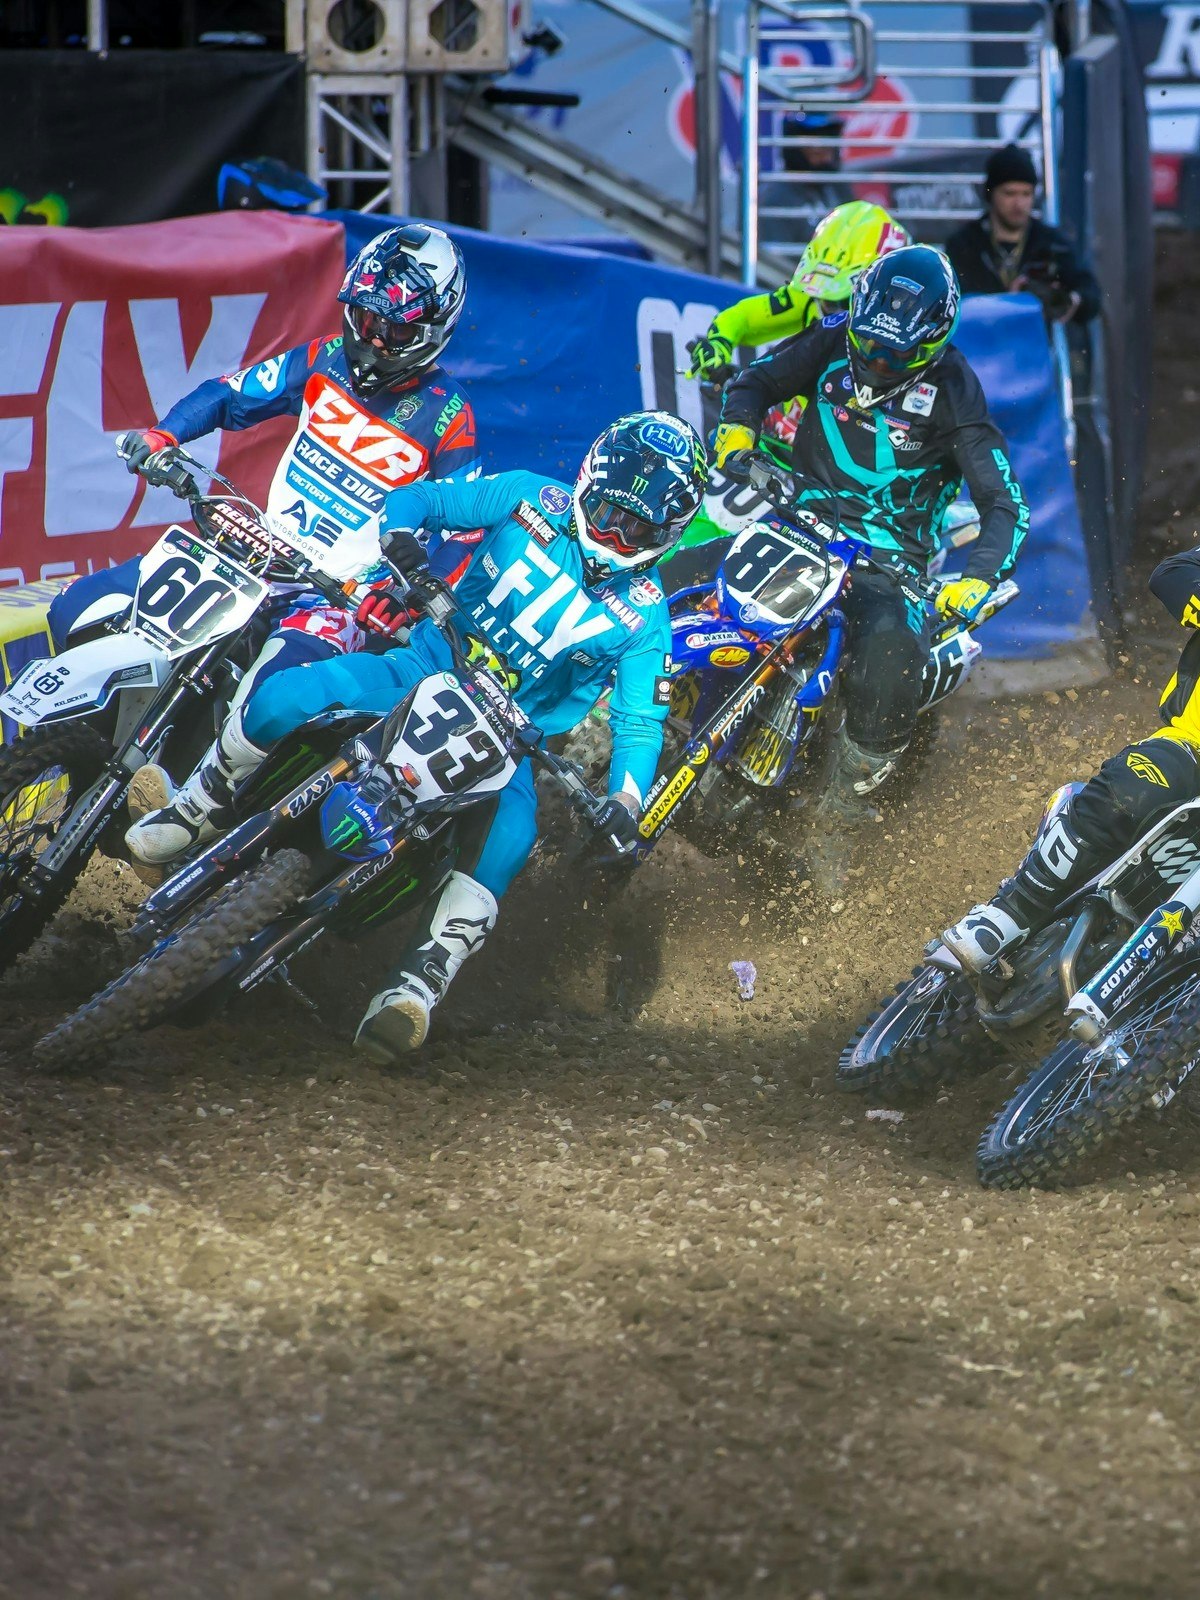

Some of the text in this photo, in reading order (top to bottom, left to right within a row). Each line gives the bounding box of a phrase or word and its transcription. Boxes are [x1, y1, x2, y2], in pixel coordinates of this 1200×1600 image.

[870, 316, 902, 334] Trader
[876, 312, 901, 327] Cycle
[310, 383, 423, 482] FXR
[296, 438, 385, 507] RACE DIV.
[288, 470, 362, 525] FACTORY RIDE
[603, 487, 654, 520] MONSTER
[214, 502, 295, 558] RENTHAL
[517, 502, 557, 543] YAMALUBE
[787, 528, 822, 552] MONSTER
[198, 549, 234, 576] MTER
[138, 556, 238, 645] 60
[486, 540, 615, 661] FLY
[601, 587, 643, 631] YAMAHA
[471, 602, 548, 678] RACING
[703, 631, 741, 643] MAXIMA
[710, 650, 751, 665] FMF
[402, 689, 506, 795] 33
[650, 770, 690, 824] DUNLOP
[352, 803, 376, 834] YAMAHA
[166, 866, 204, 899] BRAKING
